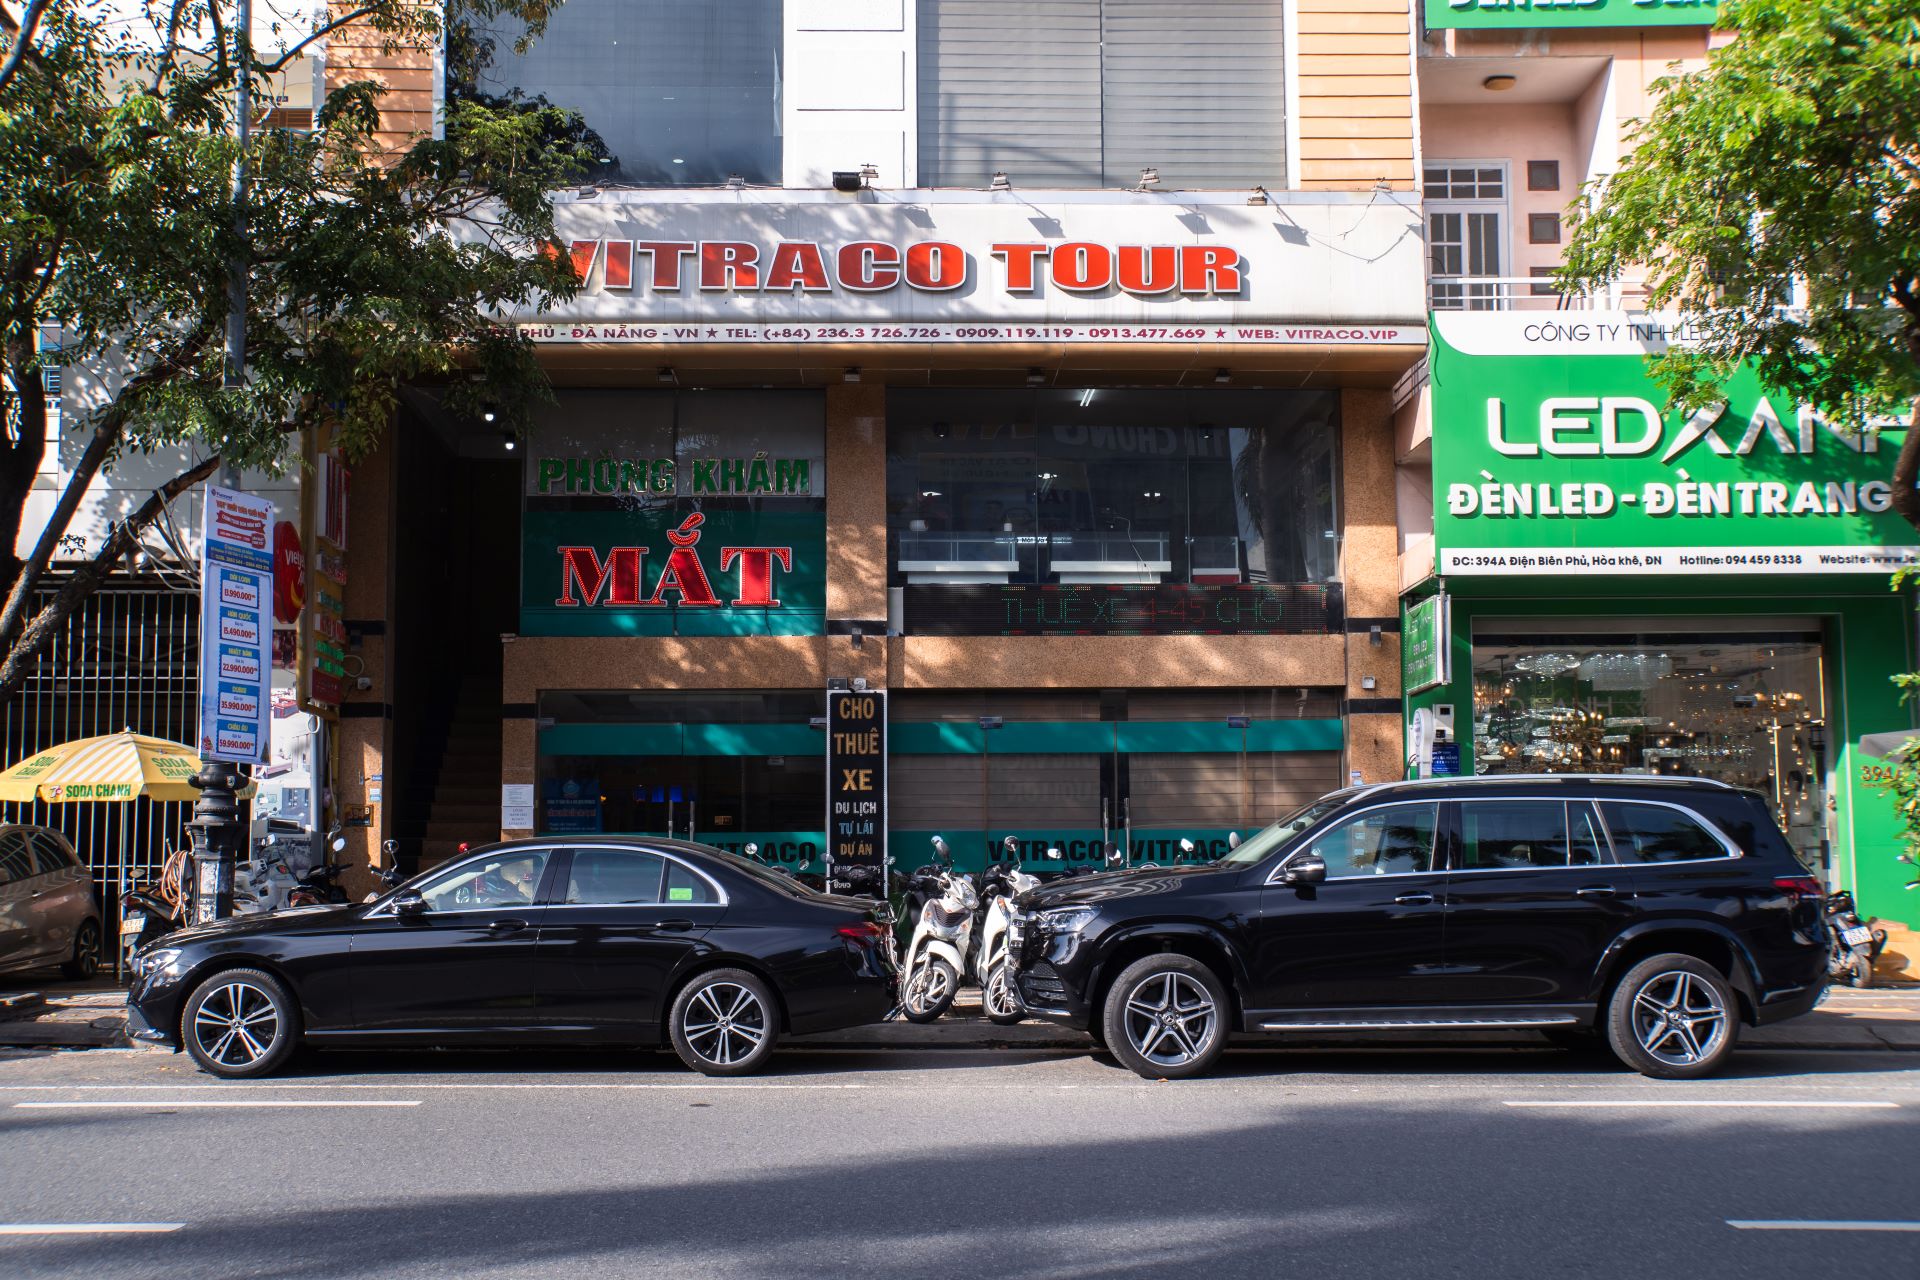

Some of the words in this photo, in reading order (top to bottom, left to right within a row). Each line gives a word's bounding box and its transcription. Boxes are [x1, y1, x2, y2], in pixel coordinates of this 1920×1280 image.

[538, 239, 967, 292] VITRACO
[990, 242, 1241, 294] TOUR
[571, 325, 598, 339] ĐÀ
[603, 324, 658, 339] NẴNG
[674, 328, 699, 339] VN
[726, 328, 758, 339] TEL:
[763, 328, 811, 341] (+84)
[817, 328, 865, 339] 236.3
[871, 328, 940, 339] 726.726
[955, 328, 1073, 339] 0909.119.119
[1088, 328, 1206, 339] 0913.477.669
[1237, 328, 1280, 340] WEB:
[1285, 328, 1399, 340] VITRACO.VIP
[1524, 320, 1591, 342] CÔNG
[1596, 325, 1620, 342] TY
[1625, 324, 1681, 341] TNHH
[538, 452, 677, 495] PHÒNG
[692, 451, 812, 495] KHÁM
[1447, 469, 1534, 515] ĐÈN
[1540, 482, 1615, 515] LED
[1642, 468, 1730, 515] ĐÈN
[1735, 480, 1893, 514] TRANG
[555, 511, 792, 607] MẮT
[1452, 556, 1474, 566] ĐC:
[1476, 556, 1507, 566] 394A
[1510, 556, 1536, 568] Điện
[1538, 556, 1563, 566] Biên
[1565, 554, 1590, 567] Phủ,
[1592, 555, 1616, 566] Hòa
[1618, 556, 1642, 567] khê,
[1645, 556, 1662, 566] ĐN
[1680, 555, 1724, 565] Hotline:
[1725, 555, 1747, 565] 094
[1750, 555, 1771, 565] 459
[1773, 555, 1802, 565] 8338
[1819, 554, 1870, 564] Website:
[1001, 588, 1081, 623] THUÊ
[1093, 598, 1128, 623] XE
[839, 697, 874, 720] CHO
[833, 727, 880, 755] THUÊ
[66, 785, 93, 798] SODA
[95, 783, 131, 797] CHANH
[842, 769, 873, 791] XE
[835, 802, 850, 814] DU
[852, 802, 877, 817] LỊCH
[856, 819, 874, 835] LÁI
[708, 841, 817, 863] ITRACO
[857, 842, 873, 856] ÁN
[988, 839, 1105, 862] VITRACO
